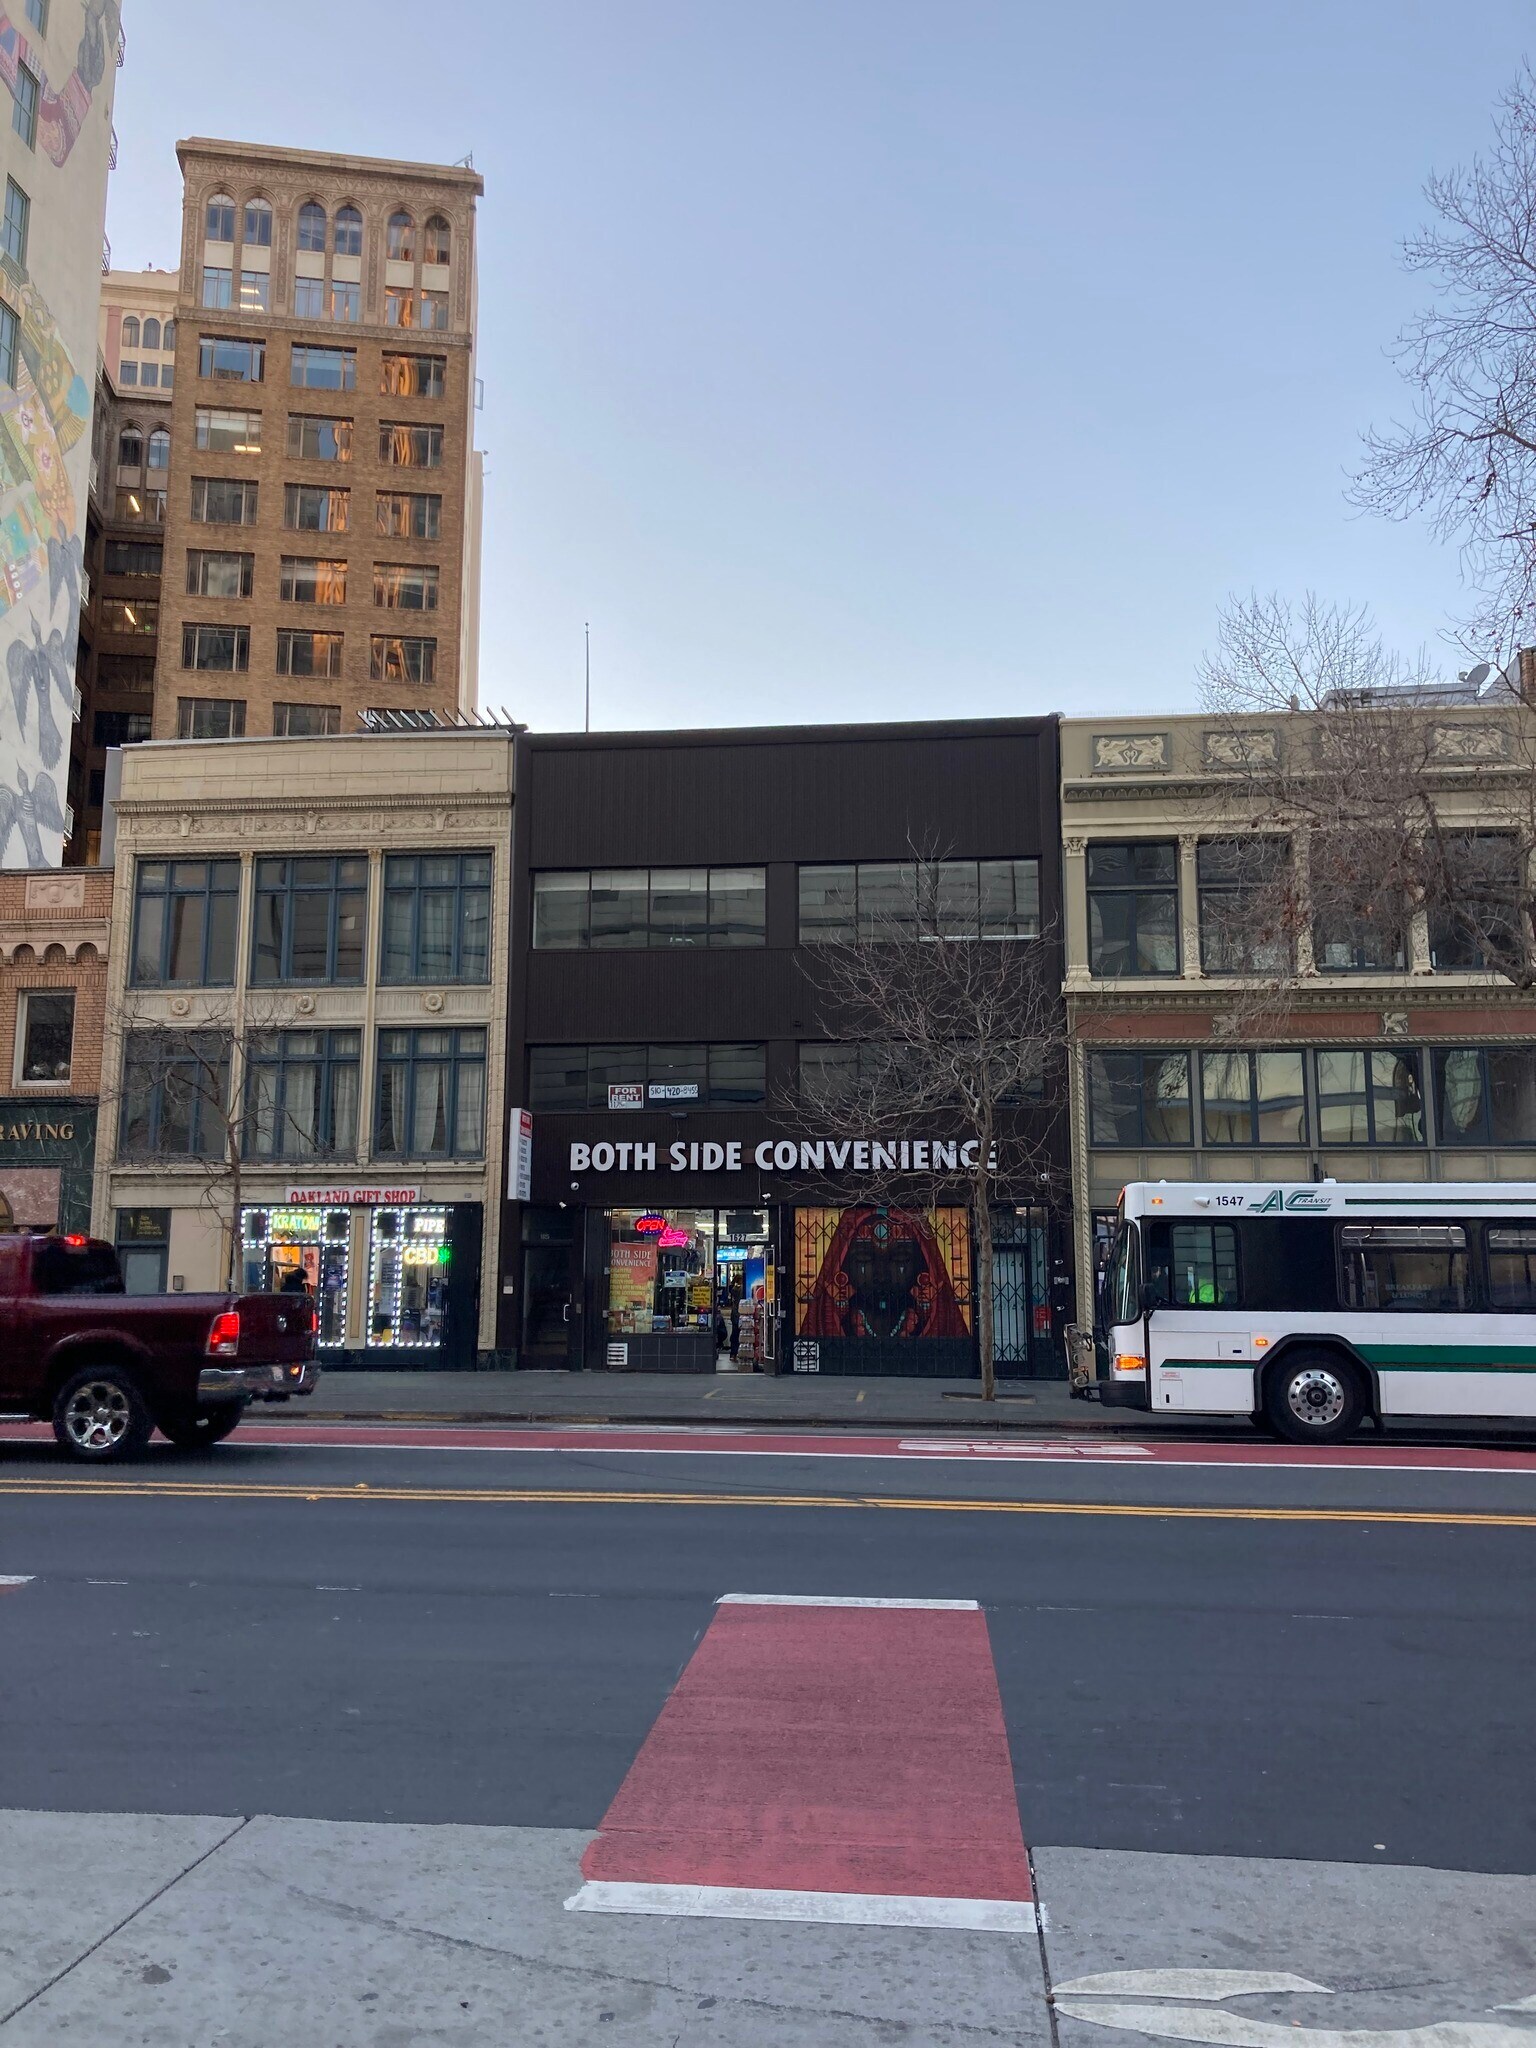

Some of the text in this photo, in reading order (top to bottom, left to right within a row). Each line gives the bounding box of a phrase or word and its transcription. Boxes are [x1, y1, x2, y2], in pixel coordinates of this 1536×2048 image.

[570, 1140, 997, 1171] BOTH SIDE CONVENIENCE
[291, 1190, 416, 1203] OAKLAND GIFT SHOP
[1216, 1196, 1244, 1206] 1547
[1247, 1190, 1332, 1213] AC
[273, 1214, 320, 1231] KRATOM
[636, 1220, 665, 1231] OPEN
[730, 1233, 747, 1241] 1627
[404, 1246, 439, 1265] CBD
[634, 1251, 652, 1260] SIDE
[611, 1259, 652, 1267] ONVENIENCE
